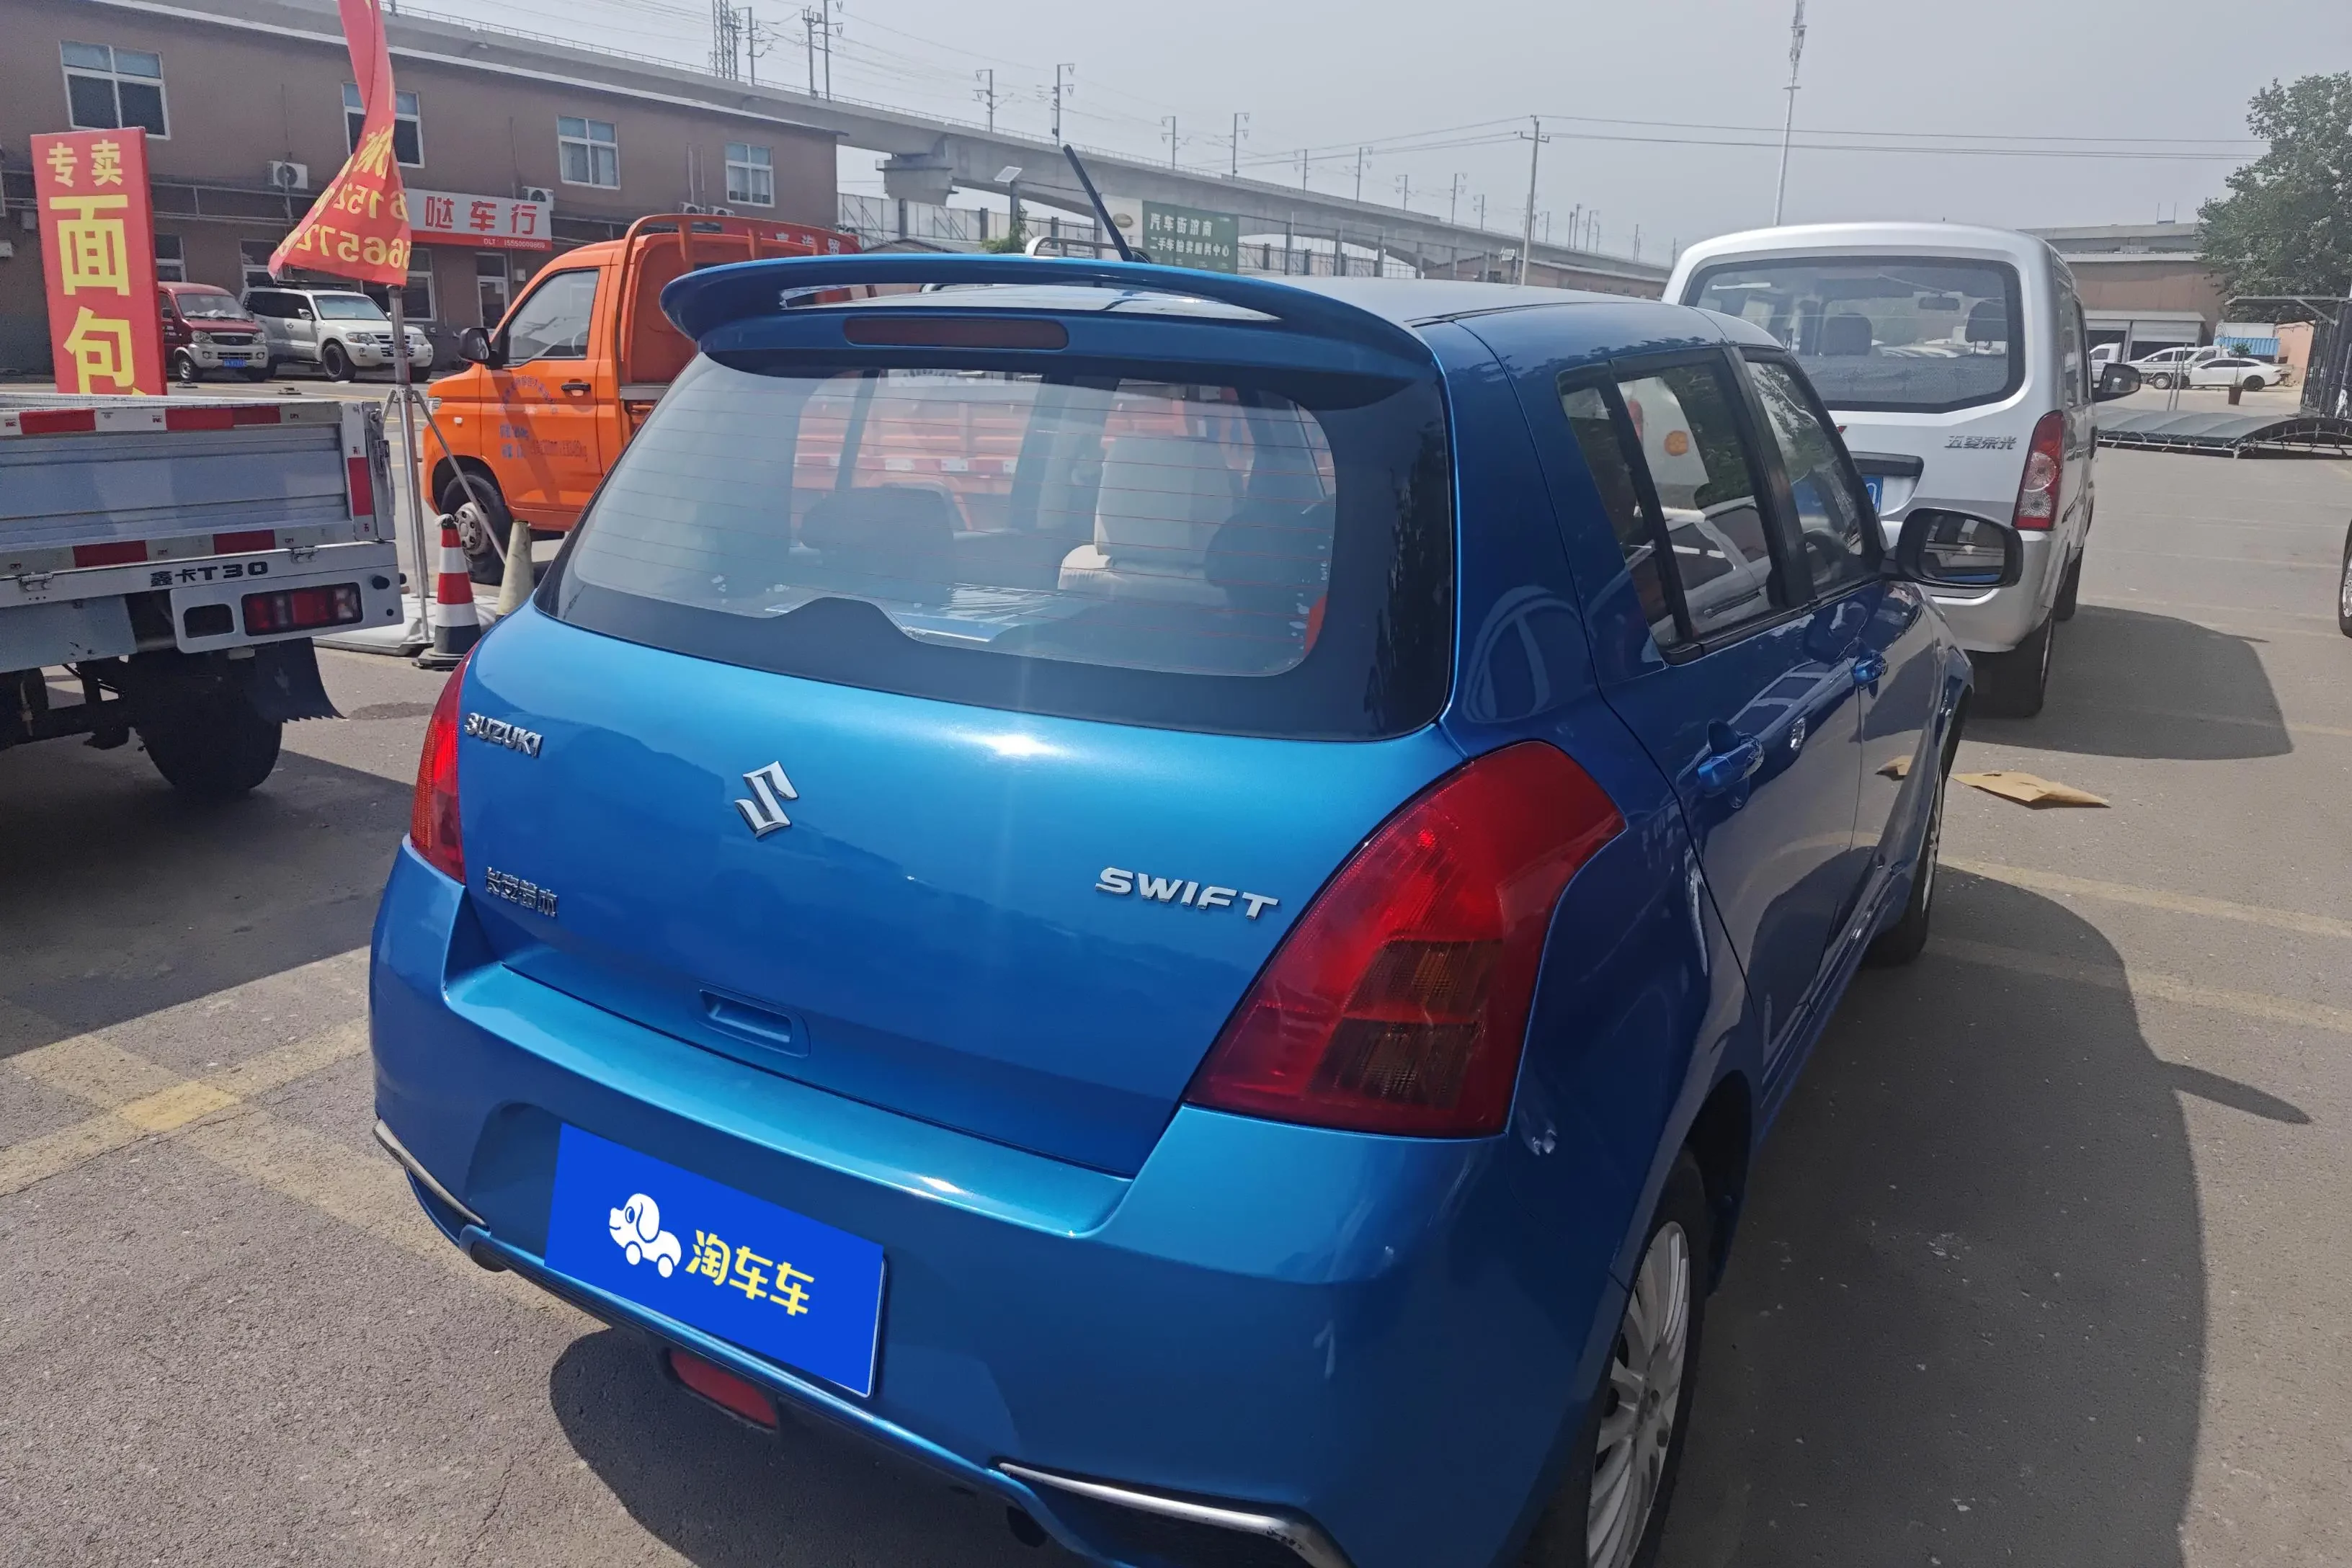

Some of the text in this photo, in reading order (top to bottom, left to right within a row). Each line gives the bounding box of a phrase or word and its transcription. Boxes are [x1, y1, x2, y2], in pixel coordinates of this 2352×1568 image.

[46, 139, 123, 188] 专卖
[425, 195, 538, 236] 哒车行
[50, 195, 147, 395] 面包
[464, 712, 544, 758] SUZUKI
[1095, 867, 1279, 920] SWIFT
